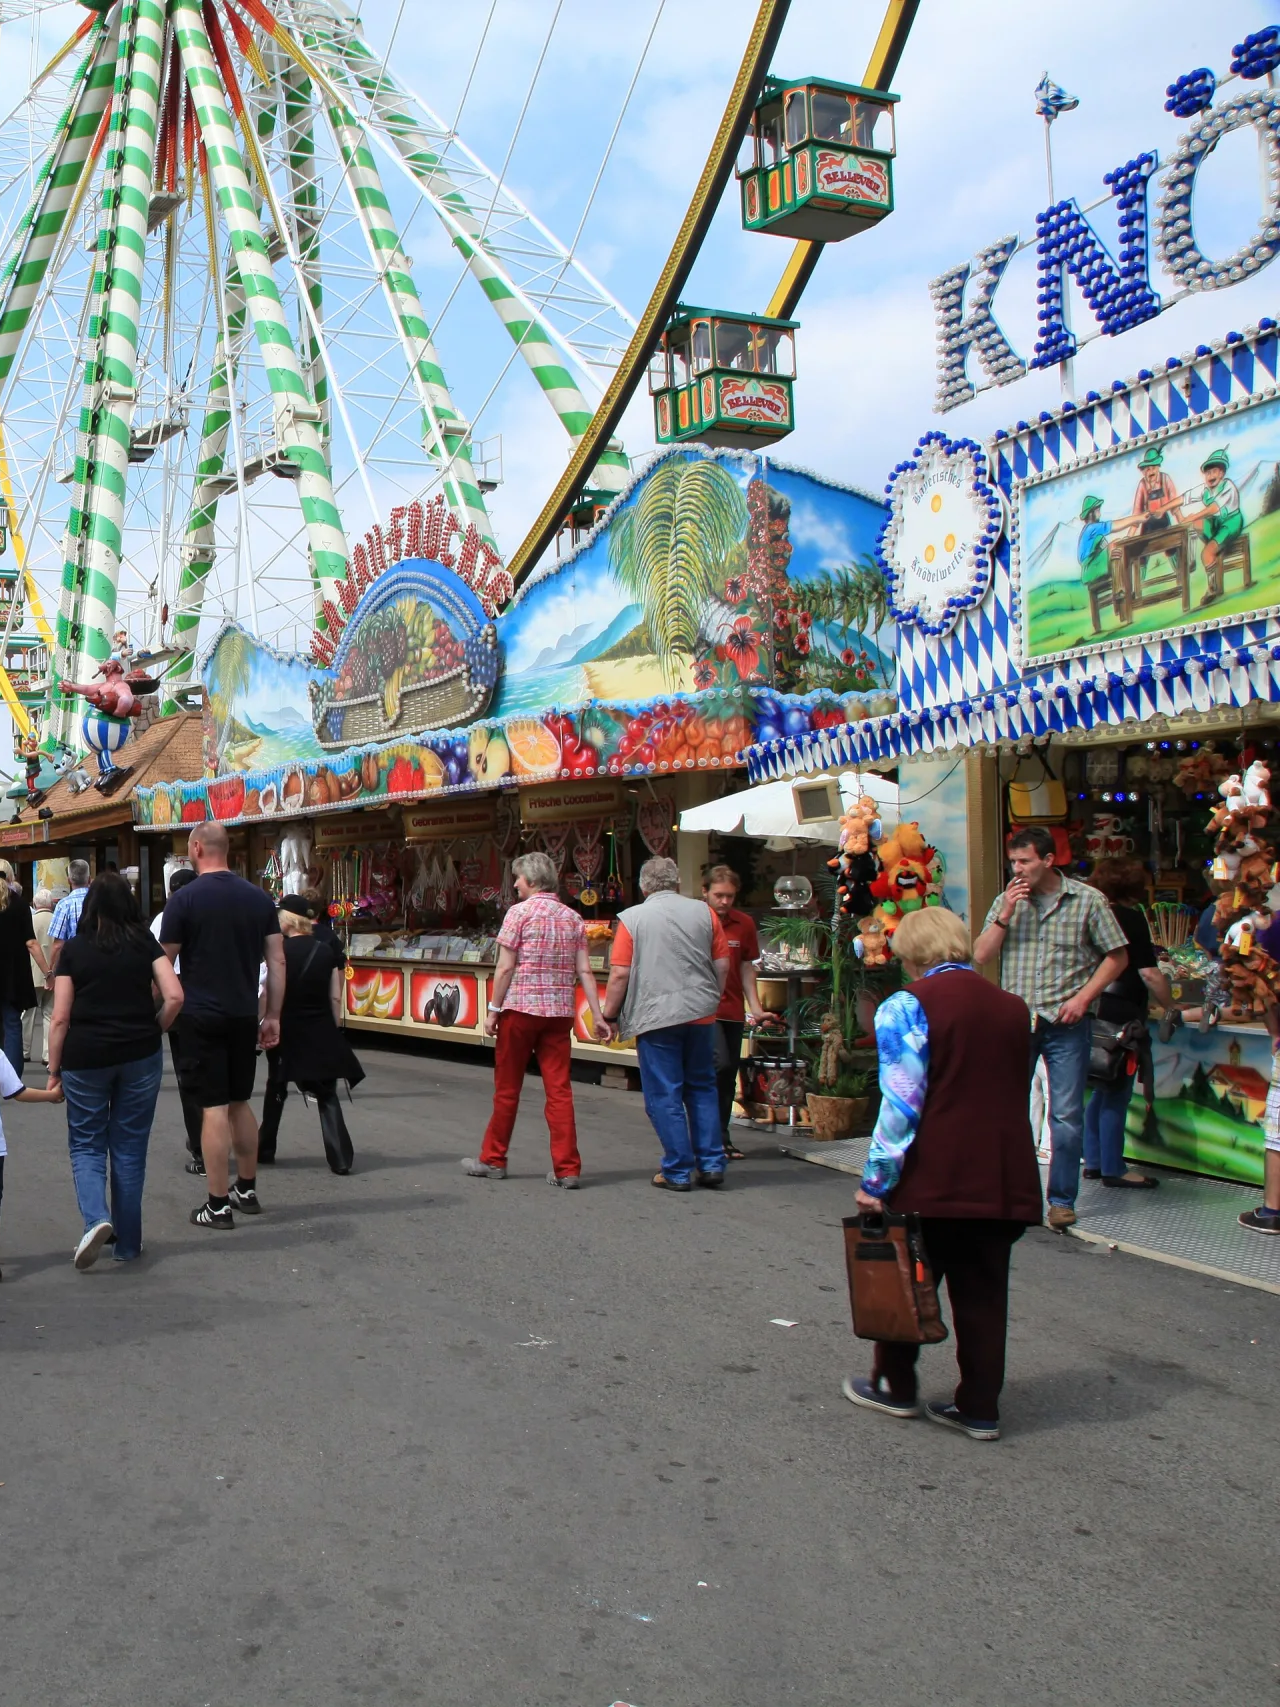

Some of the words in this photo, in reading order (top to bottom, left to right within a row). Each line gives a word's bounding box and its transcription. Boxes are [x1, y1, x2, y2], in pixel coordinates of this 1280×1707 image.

[823, 171, 880, 194] BELLEVUE
[727, 396, 781, 415] BELLEVUE
[913, 469, 961, 504] Bayerisches
[910, 542, 966, 582] Knödelwerfen
